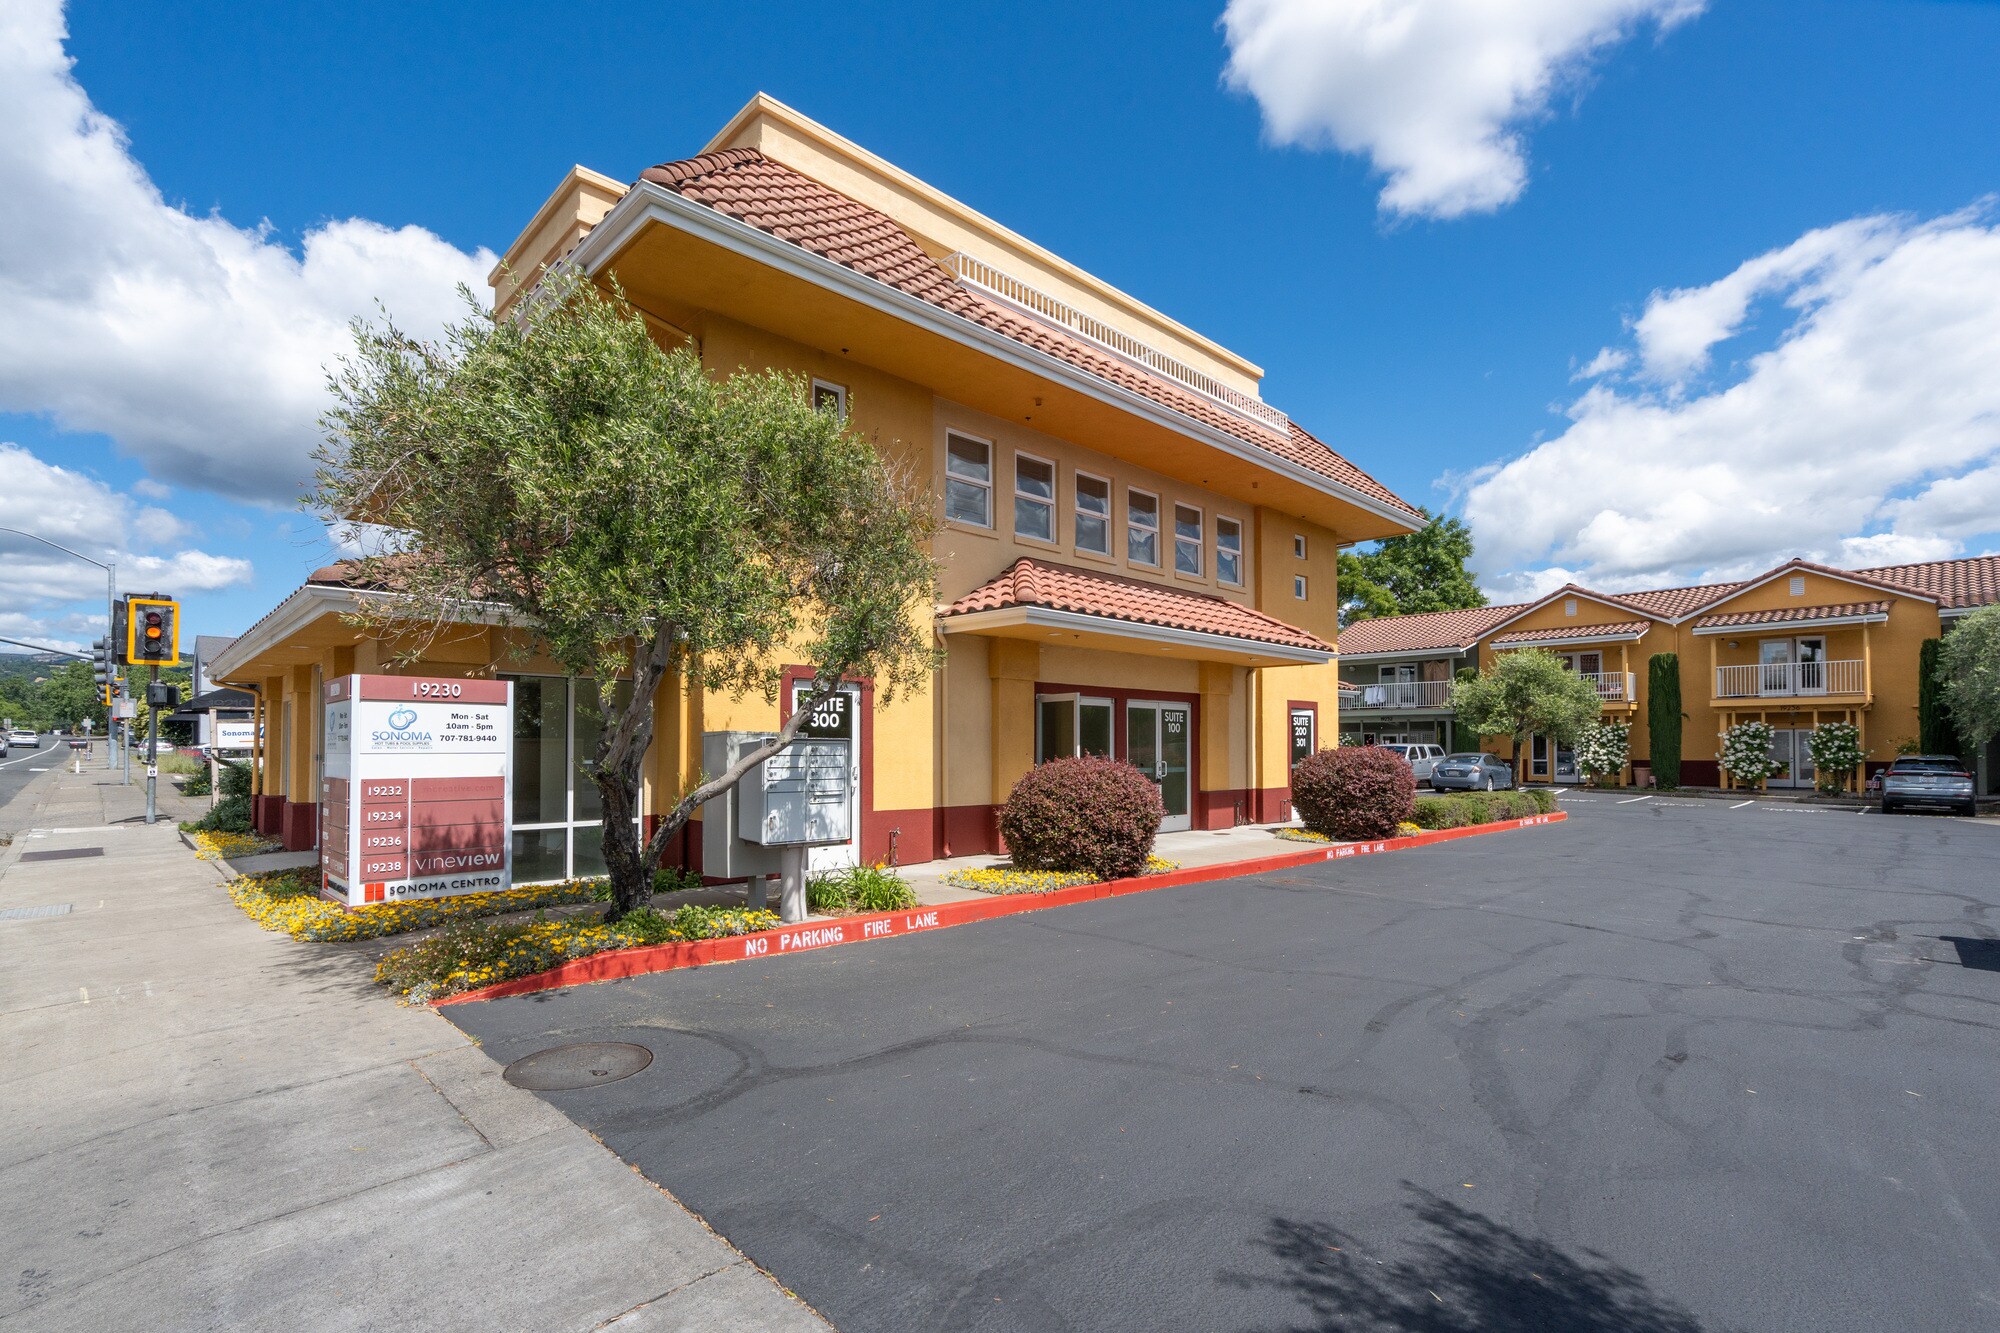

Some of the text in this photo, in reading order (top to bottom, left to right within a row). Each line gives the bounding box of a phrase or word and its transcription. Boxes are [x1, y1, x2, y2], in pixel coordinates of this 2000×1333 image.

[413, 682, 462, 698] 19230
[810, 713, 840, 727] 300
[1165, 711, 1183, 723] SUITE
[1293, 717, 1309, 726] SUITE
[476, 723, 493, 731] 5pm
[1168, 723, 1181, 733] 100
[1295, 727, 1307, 736] 200
[372, 731, 432, 741] SONOMA
[1296, 738, 1306, 747] 301
[368, 786, 402, 796] 19232
[367, 811, 402, 822] 19234
[367, 836, 402, 847] 19236
[367, 861, 402, 873] 19238
[415, 853, 500, 870] vineview
[389, 876, 500, 896] SONOMA CENTRO
[745, 911, 939, 956] NO PARKING FIRE LANE
